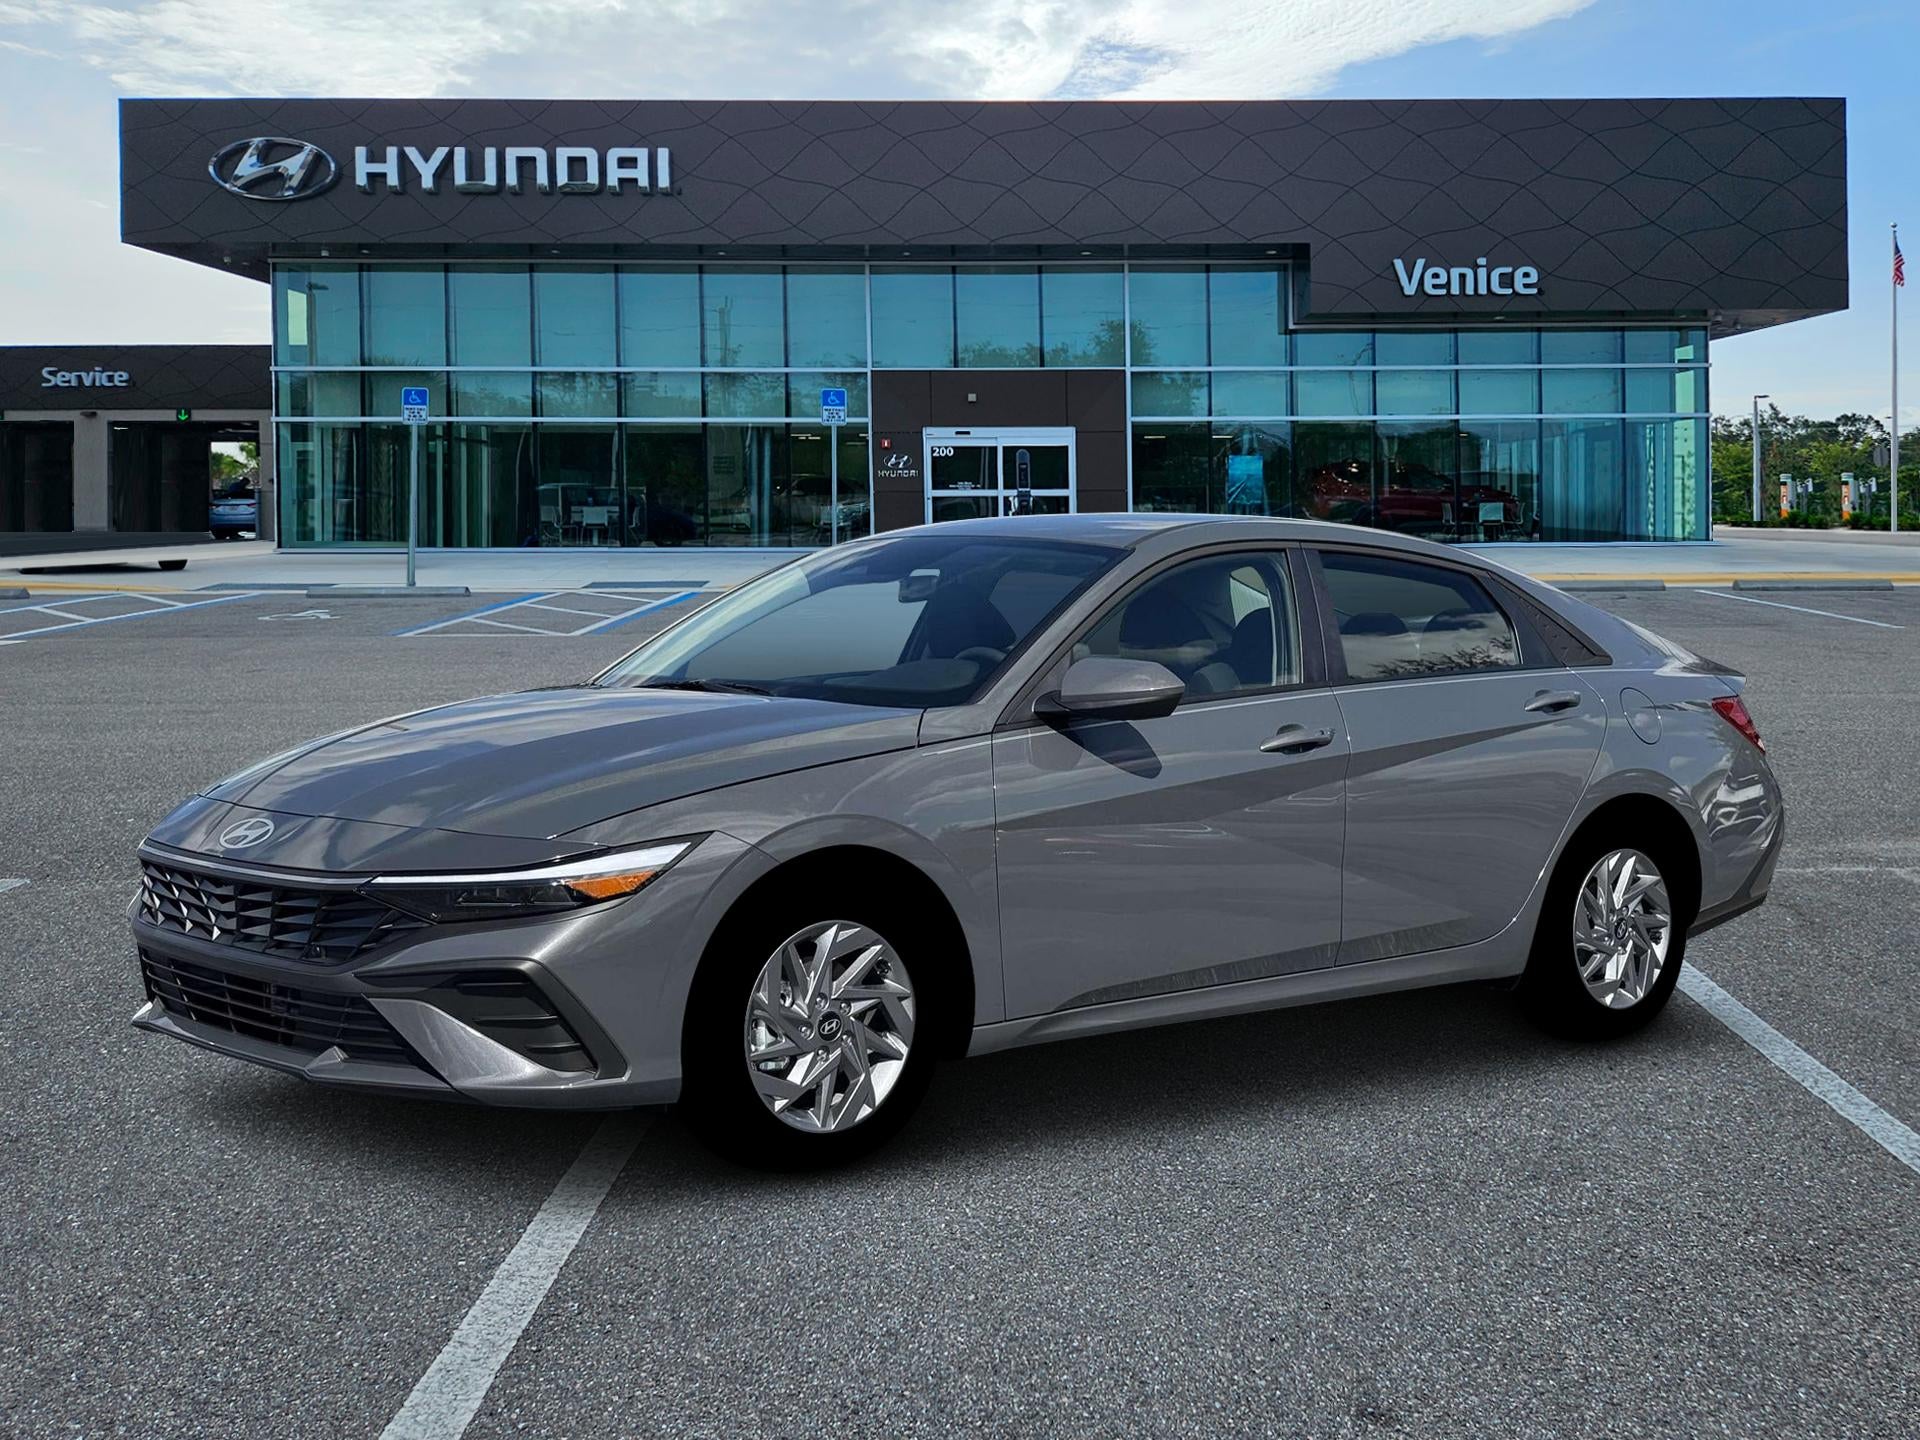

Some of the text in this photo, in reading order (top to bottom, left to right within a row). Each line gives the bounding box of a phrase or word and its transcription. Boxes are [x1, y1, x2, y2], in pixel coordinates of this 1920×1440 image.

[354, 146, 670, 194] HYUNDAI
[1392, 257, 1539, 296] Venice
[41, 366, 130, 387] Service
[932, 446, 954, 457] 200
[878, 470, 919, 478] HYUNDAI
